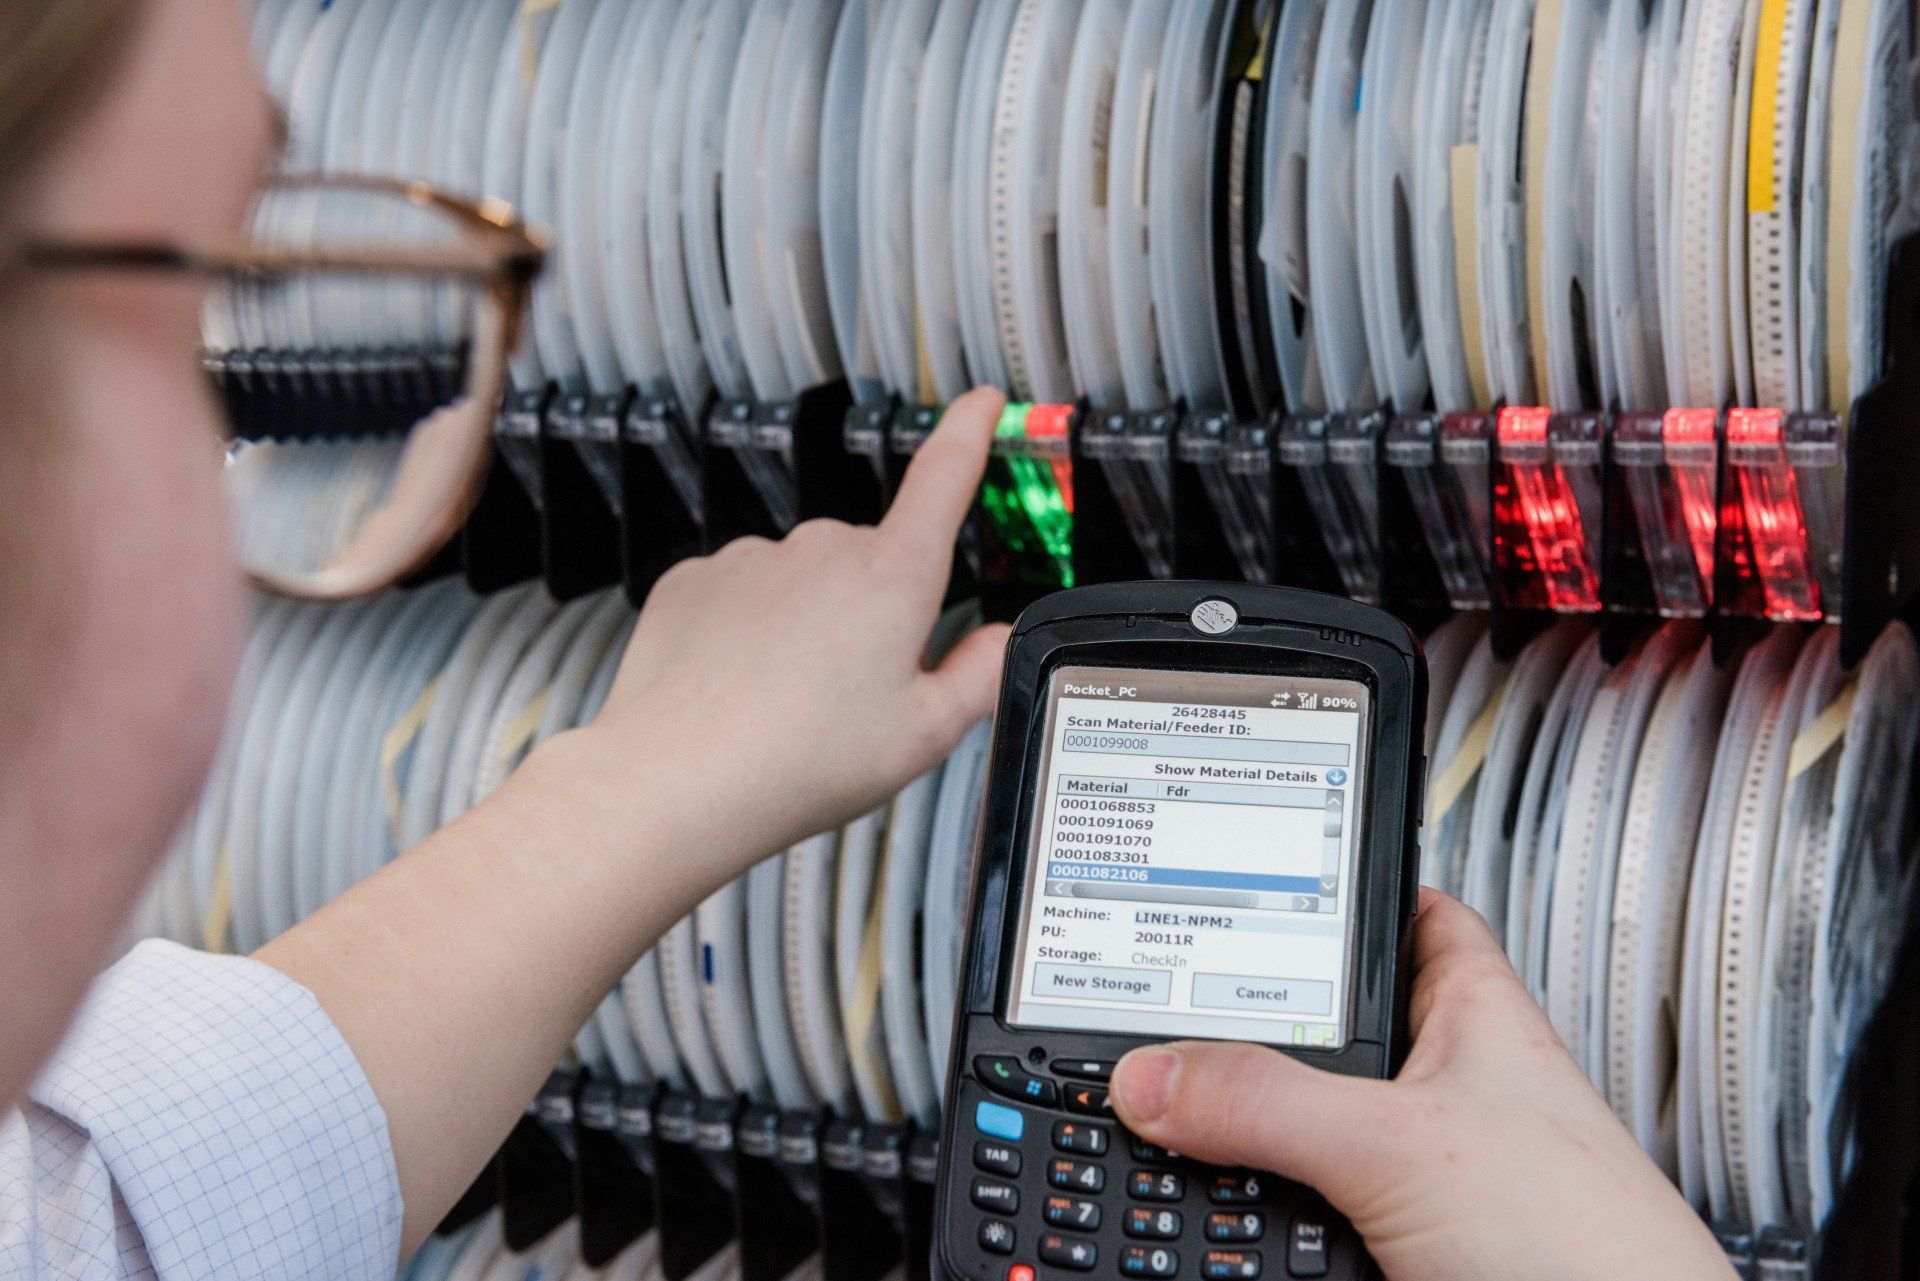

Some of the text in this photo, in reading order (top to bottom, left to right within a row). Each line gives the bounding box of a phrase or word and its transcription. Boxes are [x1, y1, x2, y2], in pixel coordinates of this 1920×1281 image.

[1064, 684, 1137, 699] Pocket_PC
[1322, 696, 1358, 710] 90%
[1171, 706, 1247, 721] 26428445
[1066, 716, 1251, 736] Scan Material/Feeder ID:
[1066, 734, 1149, 750] 0001099008
[1154, 763, 1318, 783] Show Material Details
[1066, 780, 1191, 798] Material Fdr
[1060, 798, 1156, 815] 0001068853
[1058, 814, 1154, 831] 0001091069
[1056, 831, 1153, 848] 0001091070
[1053, 848, 1150, 865] 0001083301
[1051, 864, 1149, 882] 0001082106
[1043, 906, 1234, 930] Machine: LINE1-NPM2
[1041, 925, 1194, 947] PU: 20011R
[1038, 946, 1102, 963] Storage:
[1053, 974, 1152, 994] New Storage
[1236, 986, 1288, 1002] Cancel
[1089, 1129, 1099, 1150] 1
[985, 1147, 1010, 1162] TAB
[1080, 1166, 1096, 1187] 4
[1159, 1174, 1176, 1196] 5
[1244, 1176, 1260, 1197] 6
[1078, 1202, 1094, 1223] 7
[1157, 1211, 1173, 1233] 8
[1243, 1214, 1260, 1236] 9
